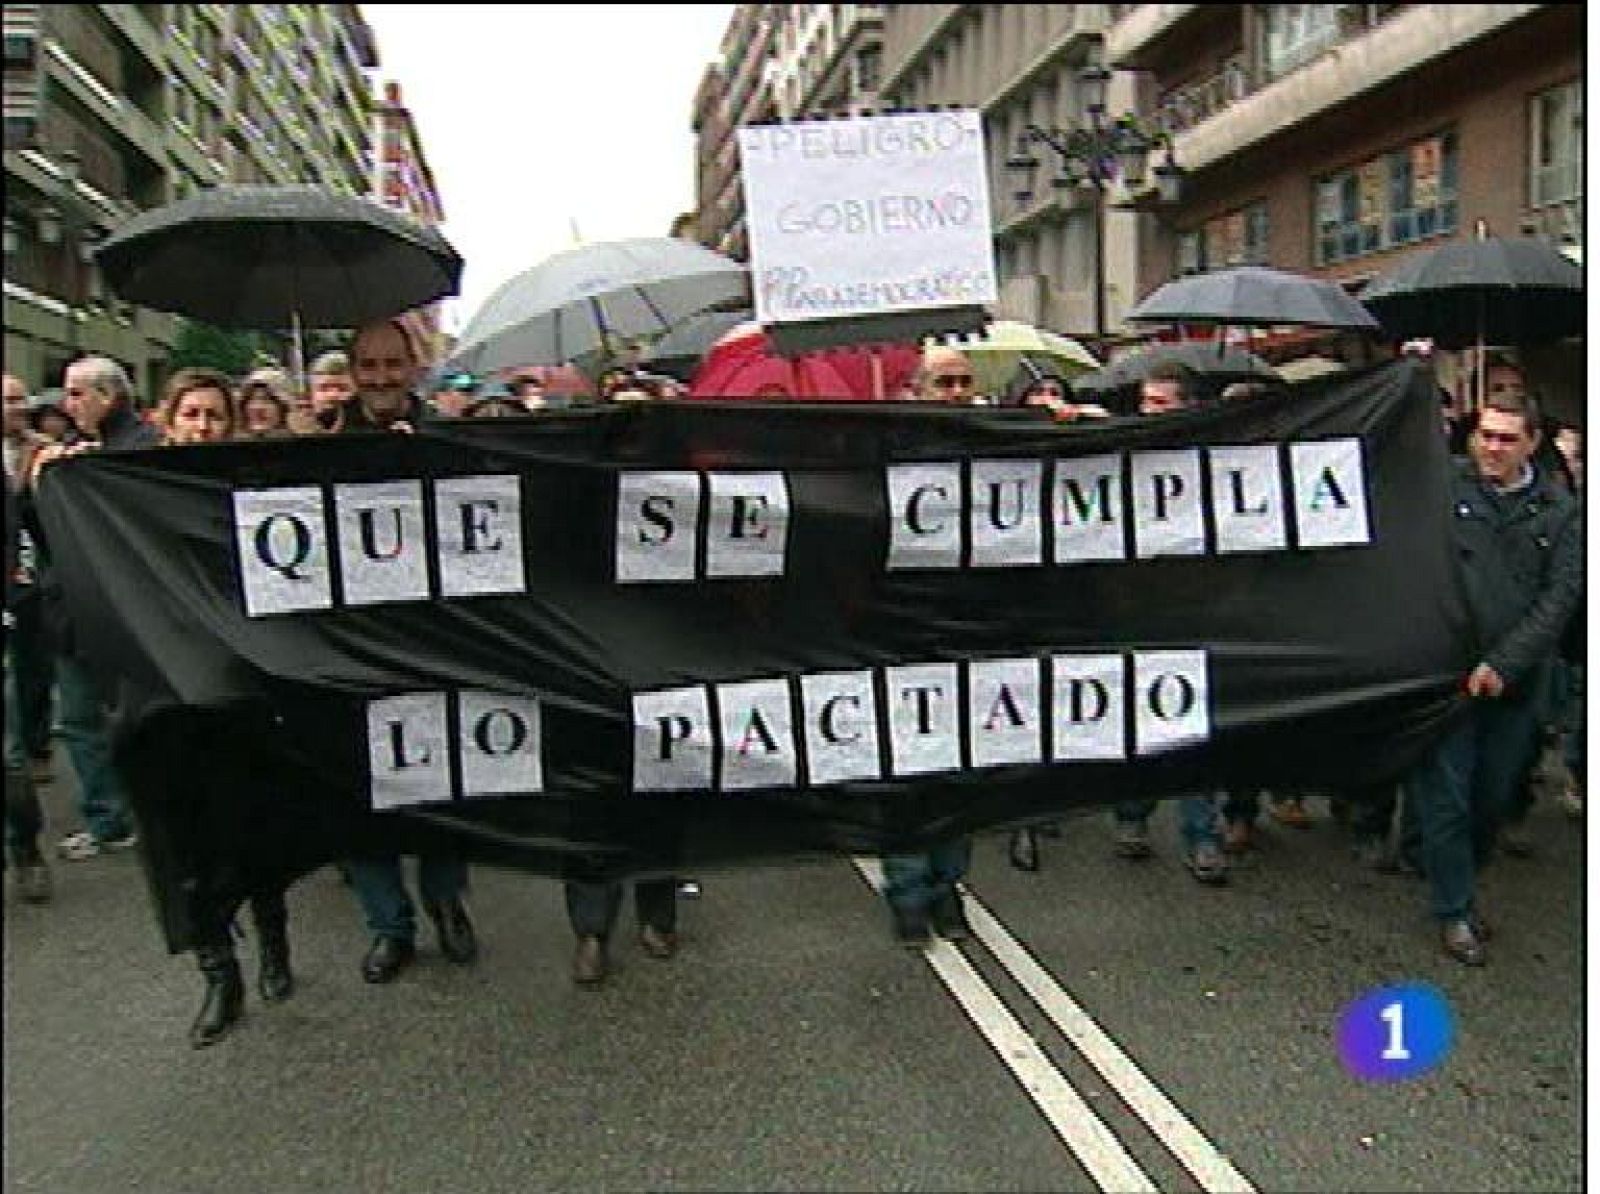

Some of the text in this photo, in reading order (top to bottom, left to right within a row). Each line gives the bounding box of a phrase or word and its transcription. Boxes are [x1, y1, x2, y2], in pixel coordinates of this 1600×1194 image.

[777, 192, 971, 234] GOBIERNO
[253, 465, 1351, 580] QUE SE CUMPLA
[387, 673, 1196, 771] LO PACTADO
